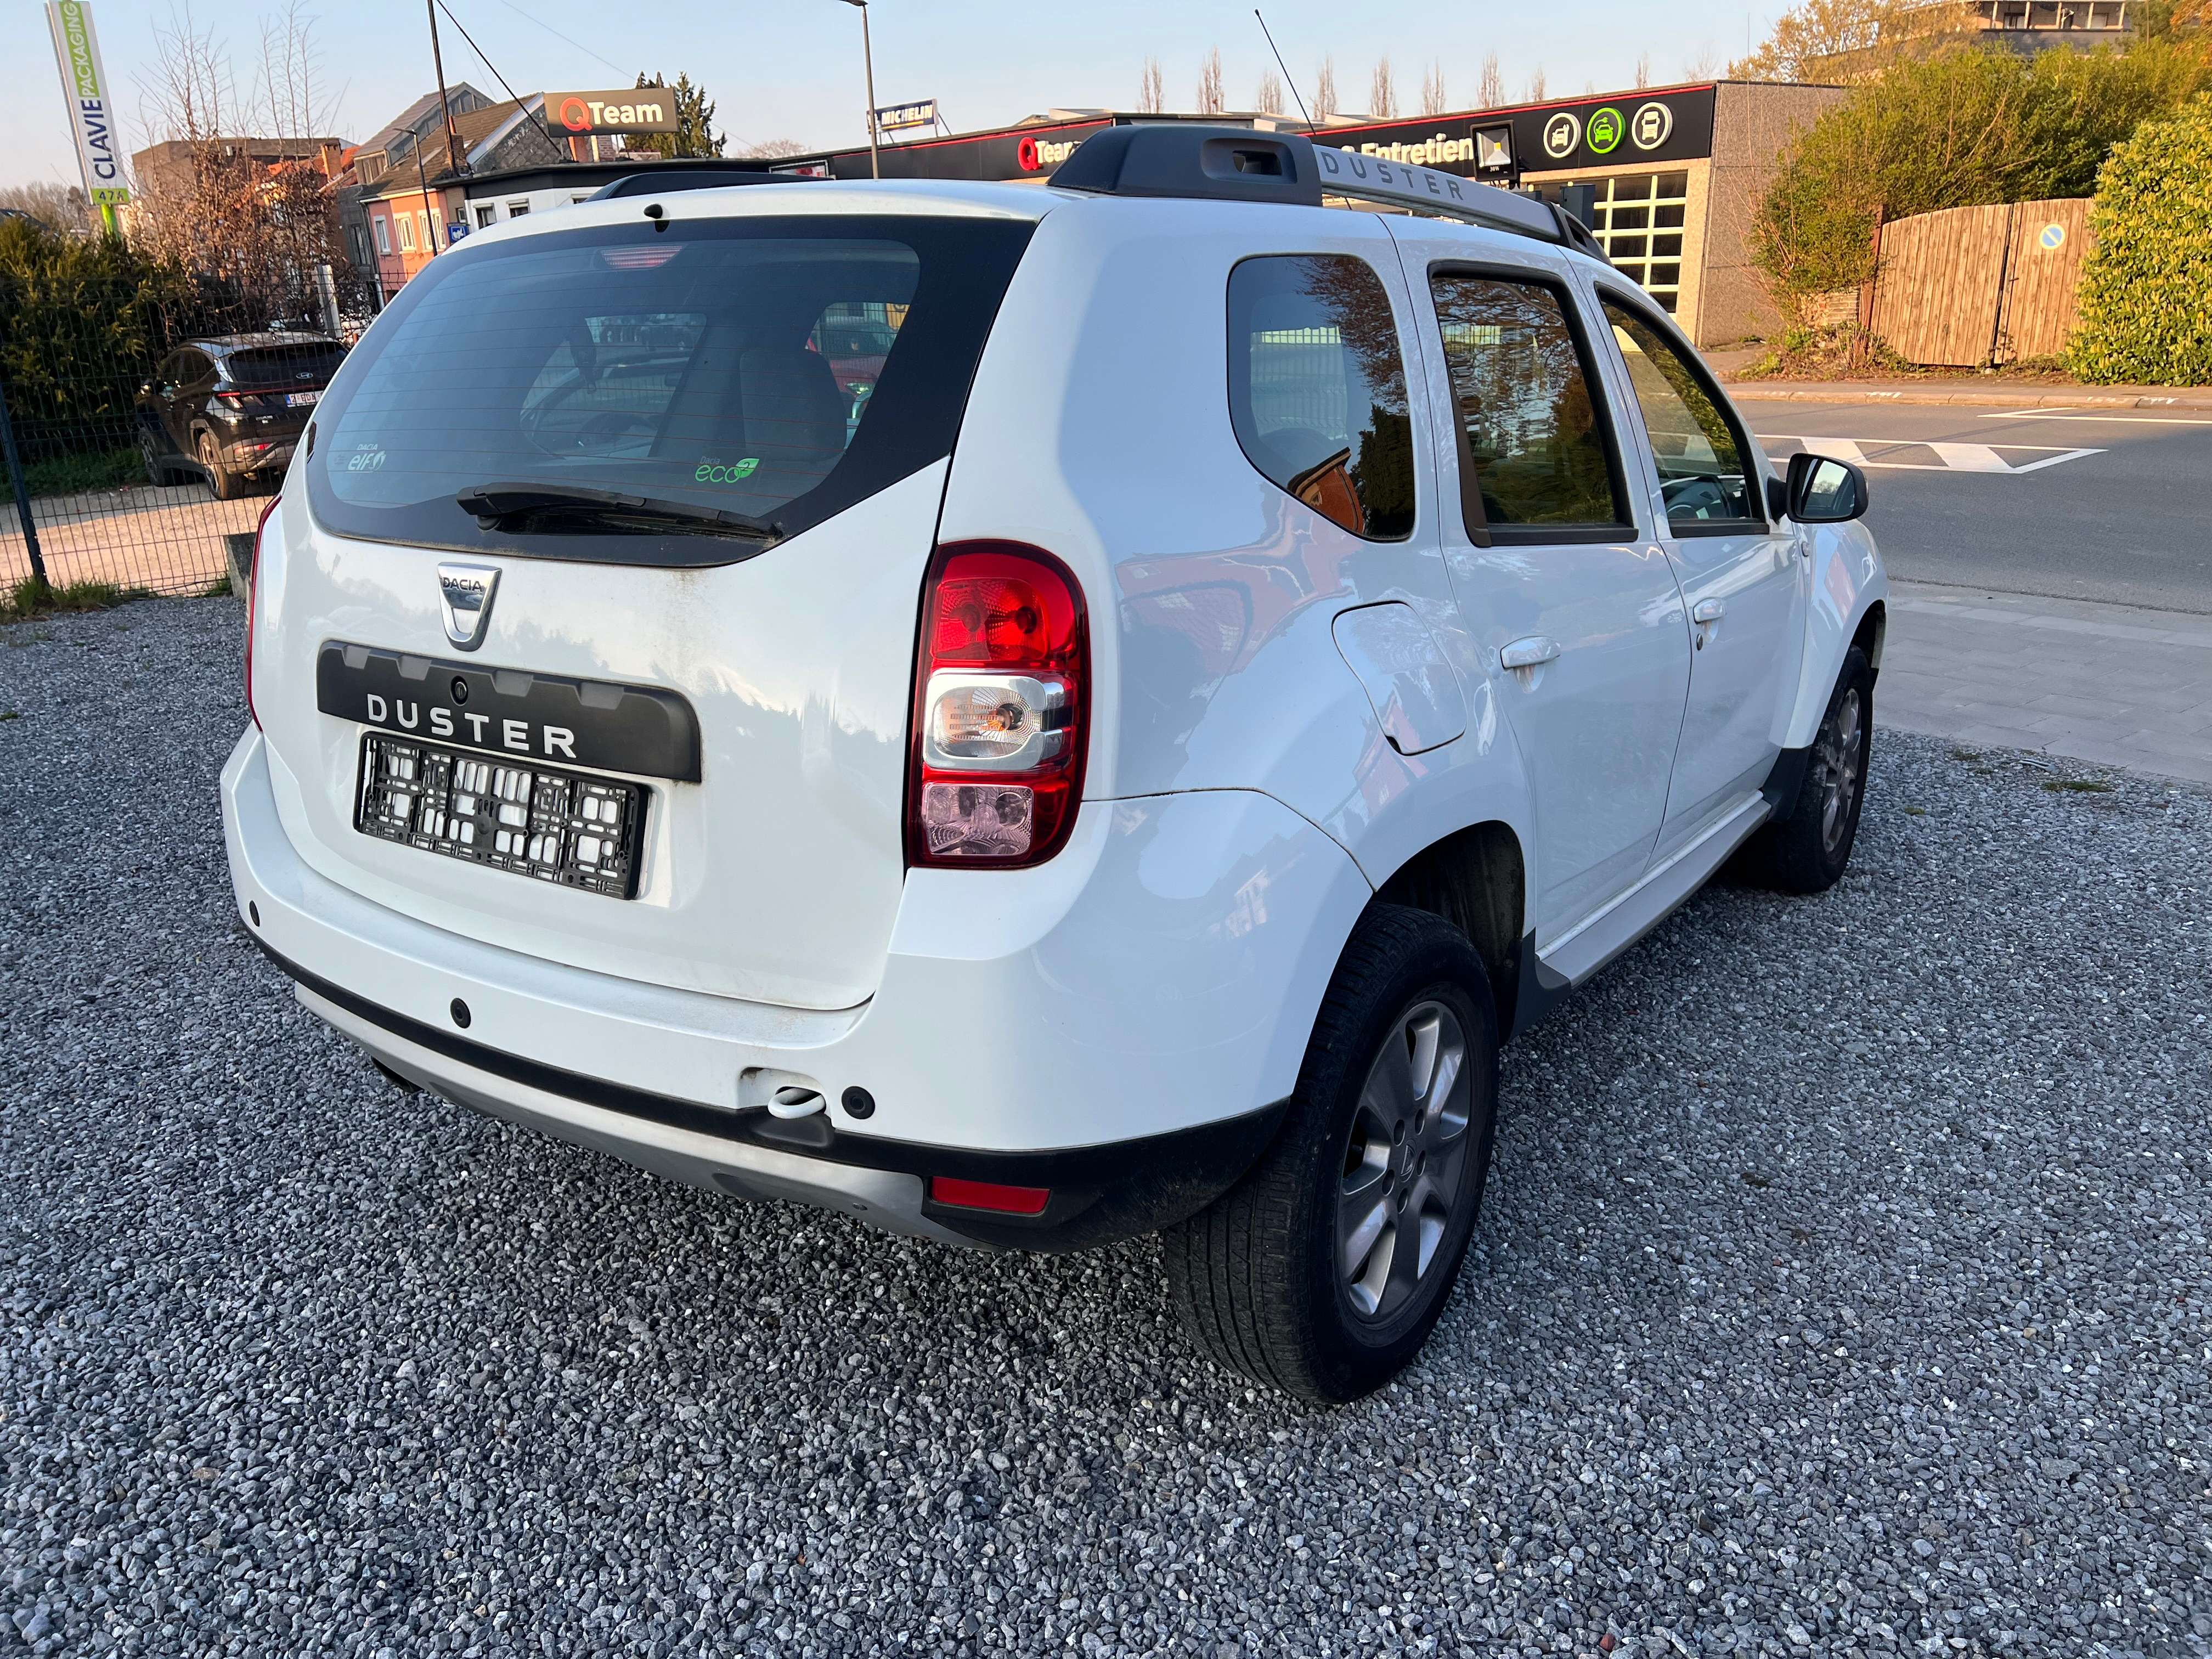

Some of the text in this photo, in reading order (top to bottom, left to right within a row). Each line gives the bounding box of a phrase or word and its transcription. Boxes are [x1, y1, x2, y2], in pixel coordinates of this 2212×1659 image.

[63, 3, 116, 179] CLAVIE PACKAGING
[559, 97, 663, 132] QTeam
[881, 104, 933, 125] MICHELIN
[1321, 151, 1464, 201] DUSTER
[348, 453, 374, 470] elf
[699, 456, 720, 465] Dacia
[443, 577, 483, 592] DACIA
[366, 693, 578, 759] DUSTER
